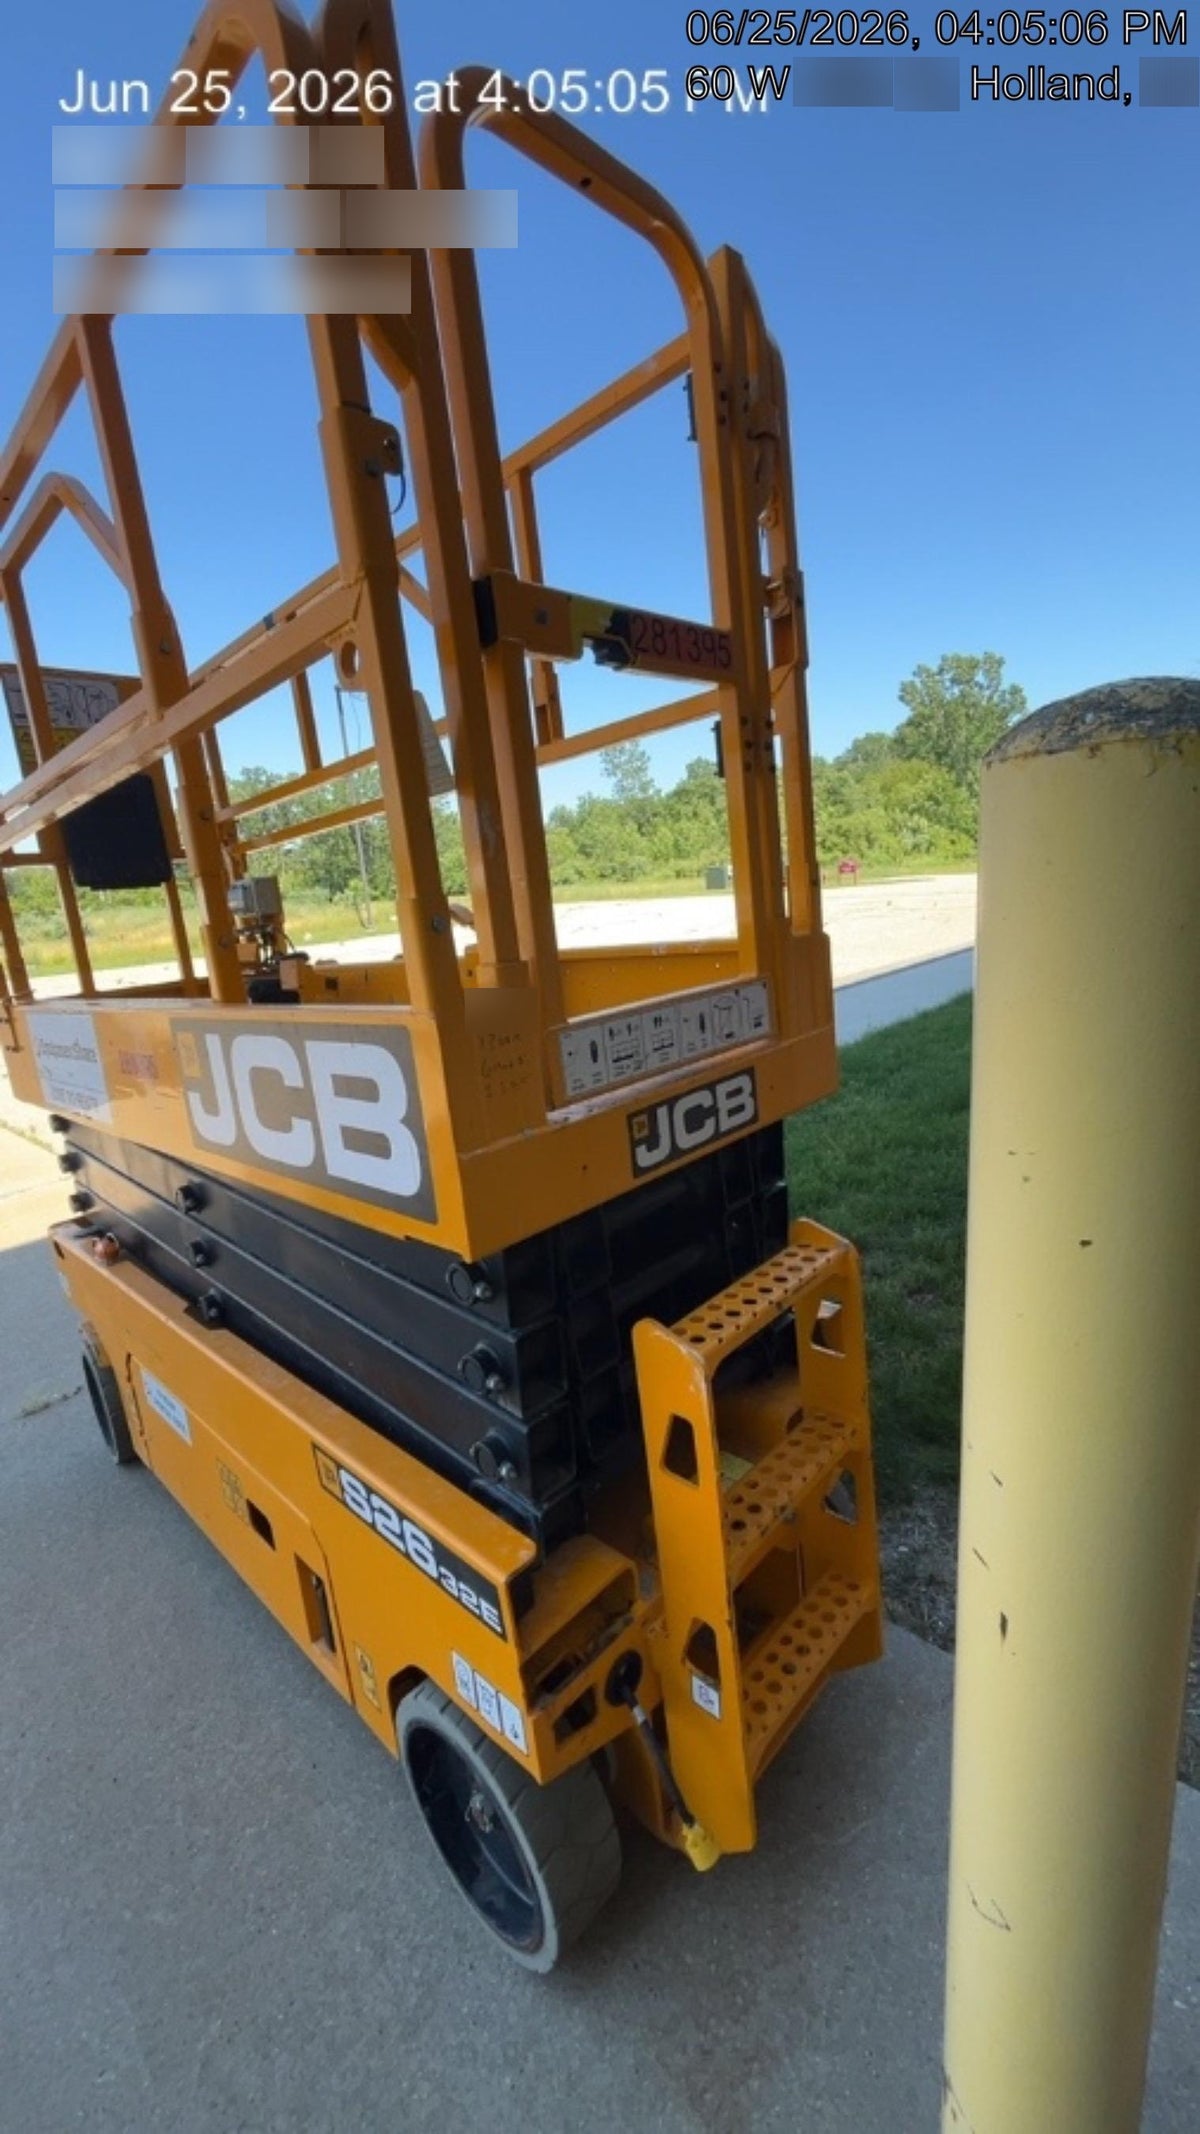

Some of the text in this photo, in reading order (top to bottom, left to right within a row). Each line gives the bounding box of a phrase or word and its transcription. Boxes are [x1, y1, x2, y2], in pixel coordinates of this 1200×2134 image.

[631, 613, 732, 671] 281395
[187, 1033, 421, 1197] JCB
[635, 1074, 756, 1168] JCB
